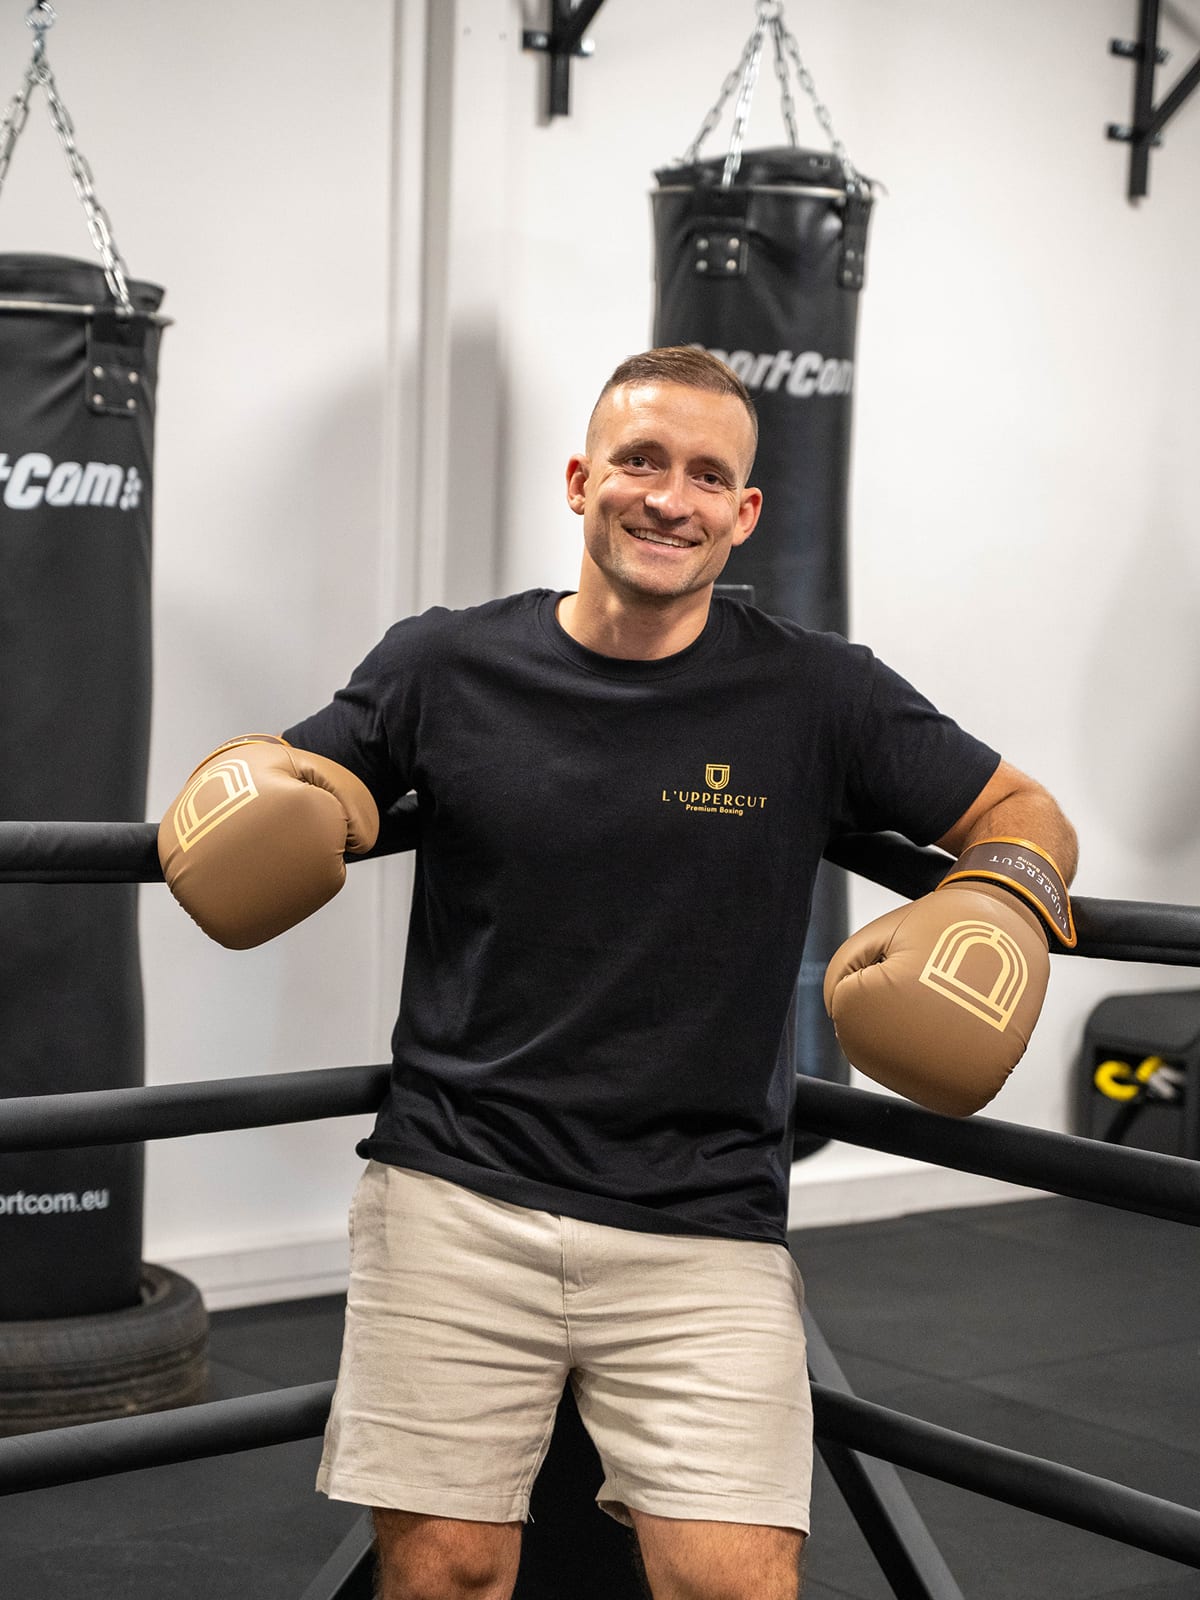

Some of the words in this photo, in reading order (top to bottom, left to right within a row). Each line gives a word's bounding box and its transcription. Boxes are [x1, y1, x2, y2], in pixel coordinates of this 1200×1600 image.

[662, 790, 767, 809] L'UPPERCUT
[685, 804, 718, 813] Premium
[719, 806, 744, 816] Boxing
[989, 855, 1068, 929] L'UPPERCUT
